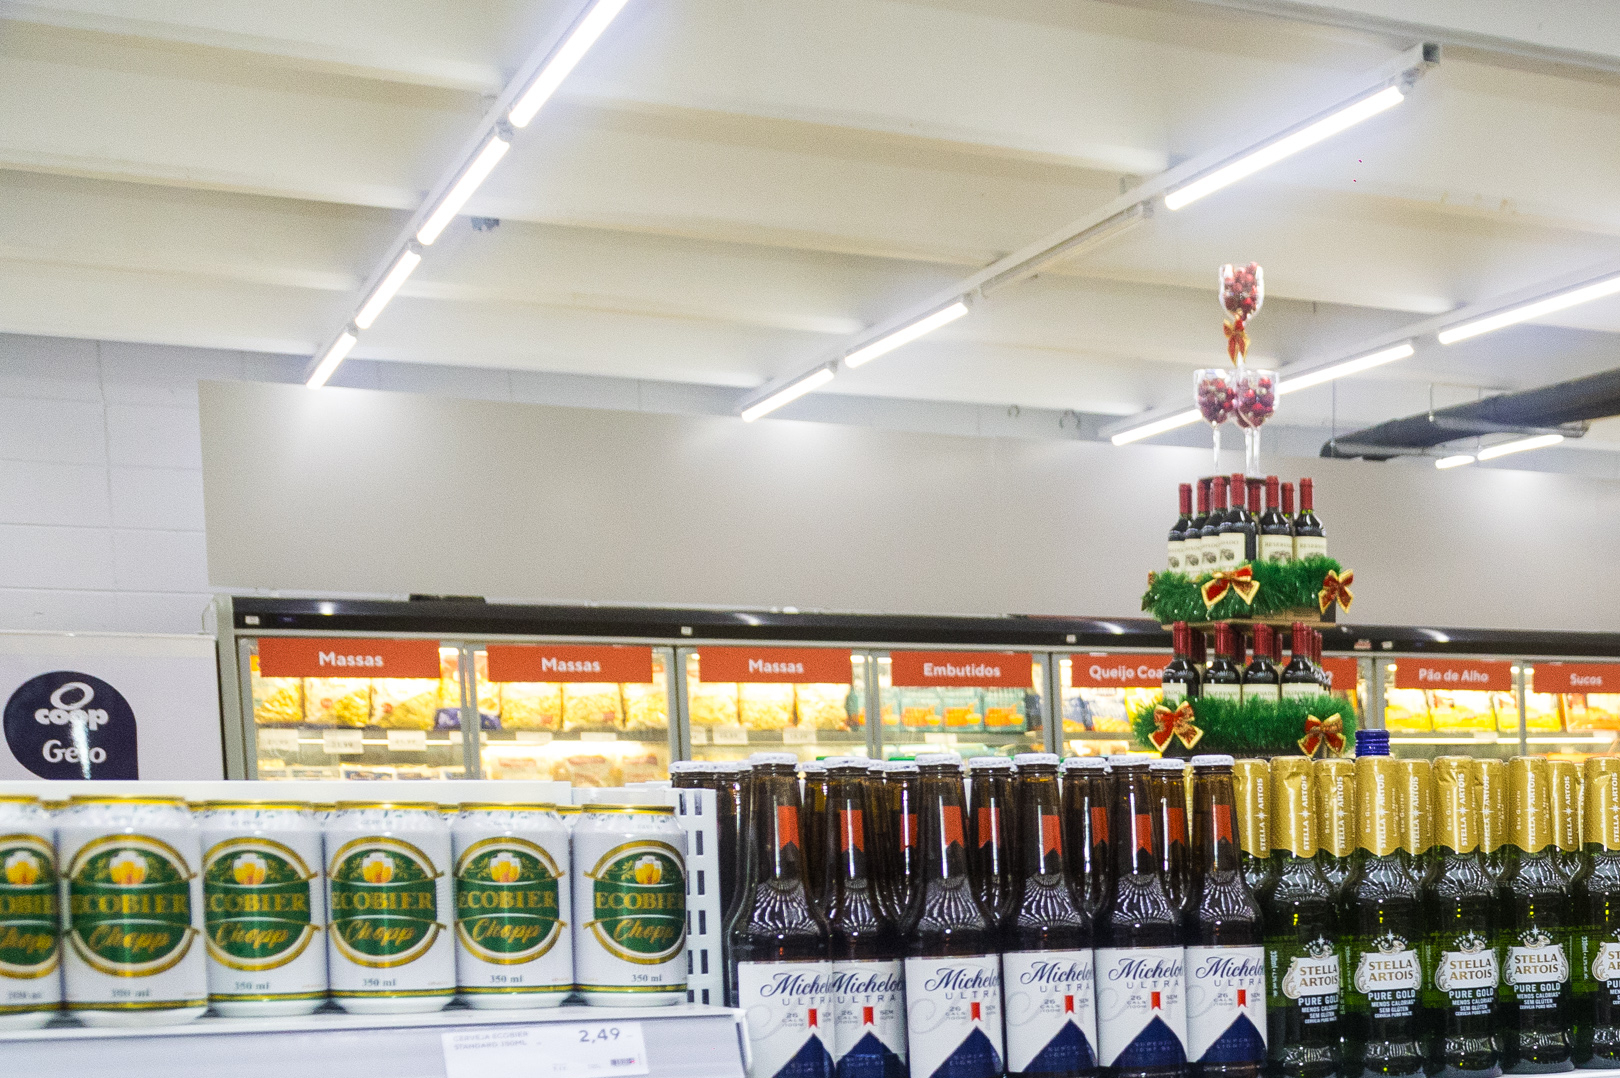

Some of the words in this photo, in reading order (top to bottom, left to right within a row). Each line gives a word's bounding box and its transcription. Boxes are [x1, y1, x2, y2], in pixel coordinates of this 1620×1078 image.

[318, 651, 384, 668] Massas
[540, 656, 601, 674] Massas
[748, 658, 804, 675] Massas
[923, 661, 1001, 679] Embutidos
[1089, 664, 1135, 682] Queijo
[1418, 668, 1441, 685] Pão
[1443, 669, 1458, 683] de
[1461, 669, 1489, 684] Alho
[1569, 673, 1602, 687] Sucos
[34, 708, 109, 731] coop
[42, 739, 107, 764] Geo
[345, 917, 414, 950] Chopp
[472, 918, 542, 944] Chopp
[612, 918, 675, 944] Chopp
[1368, 959, 1413, 971] STELLA
[1514, 953, 1558, 964] STELLA
[1368, 970, 1414, 982] ARTOIS
[1514, 964, 1559, 975] ARTOIS
[631, 974, 648, 984] 350
[650, 973, 662, 983] ml
[1127, 980, 1180, 989] ULTRA
[1040, 983, 1091, 993] ULTRA
[1368, 992, 1393, 1000] PURE
[1395, 990, 1416, 999] GOLD
[1513, 984, 1537, 993] PURE
[1540, 982, 1561, 992] GOLD
[838, 994, 895, 1004] ULTRA
[578, 1027, 621, 1044] 2,49
